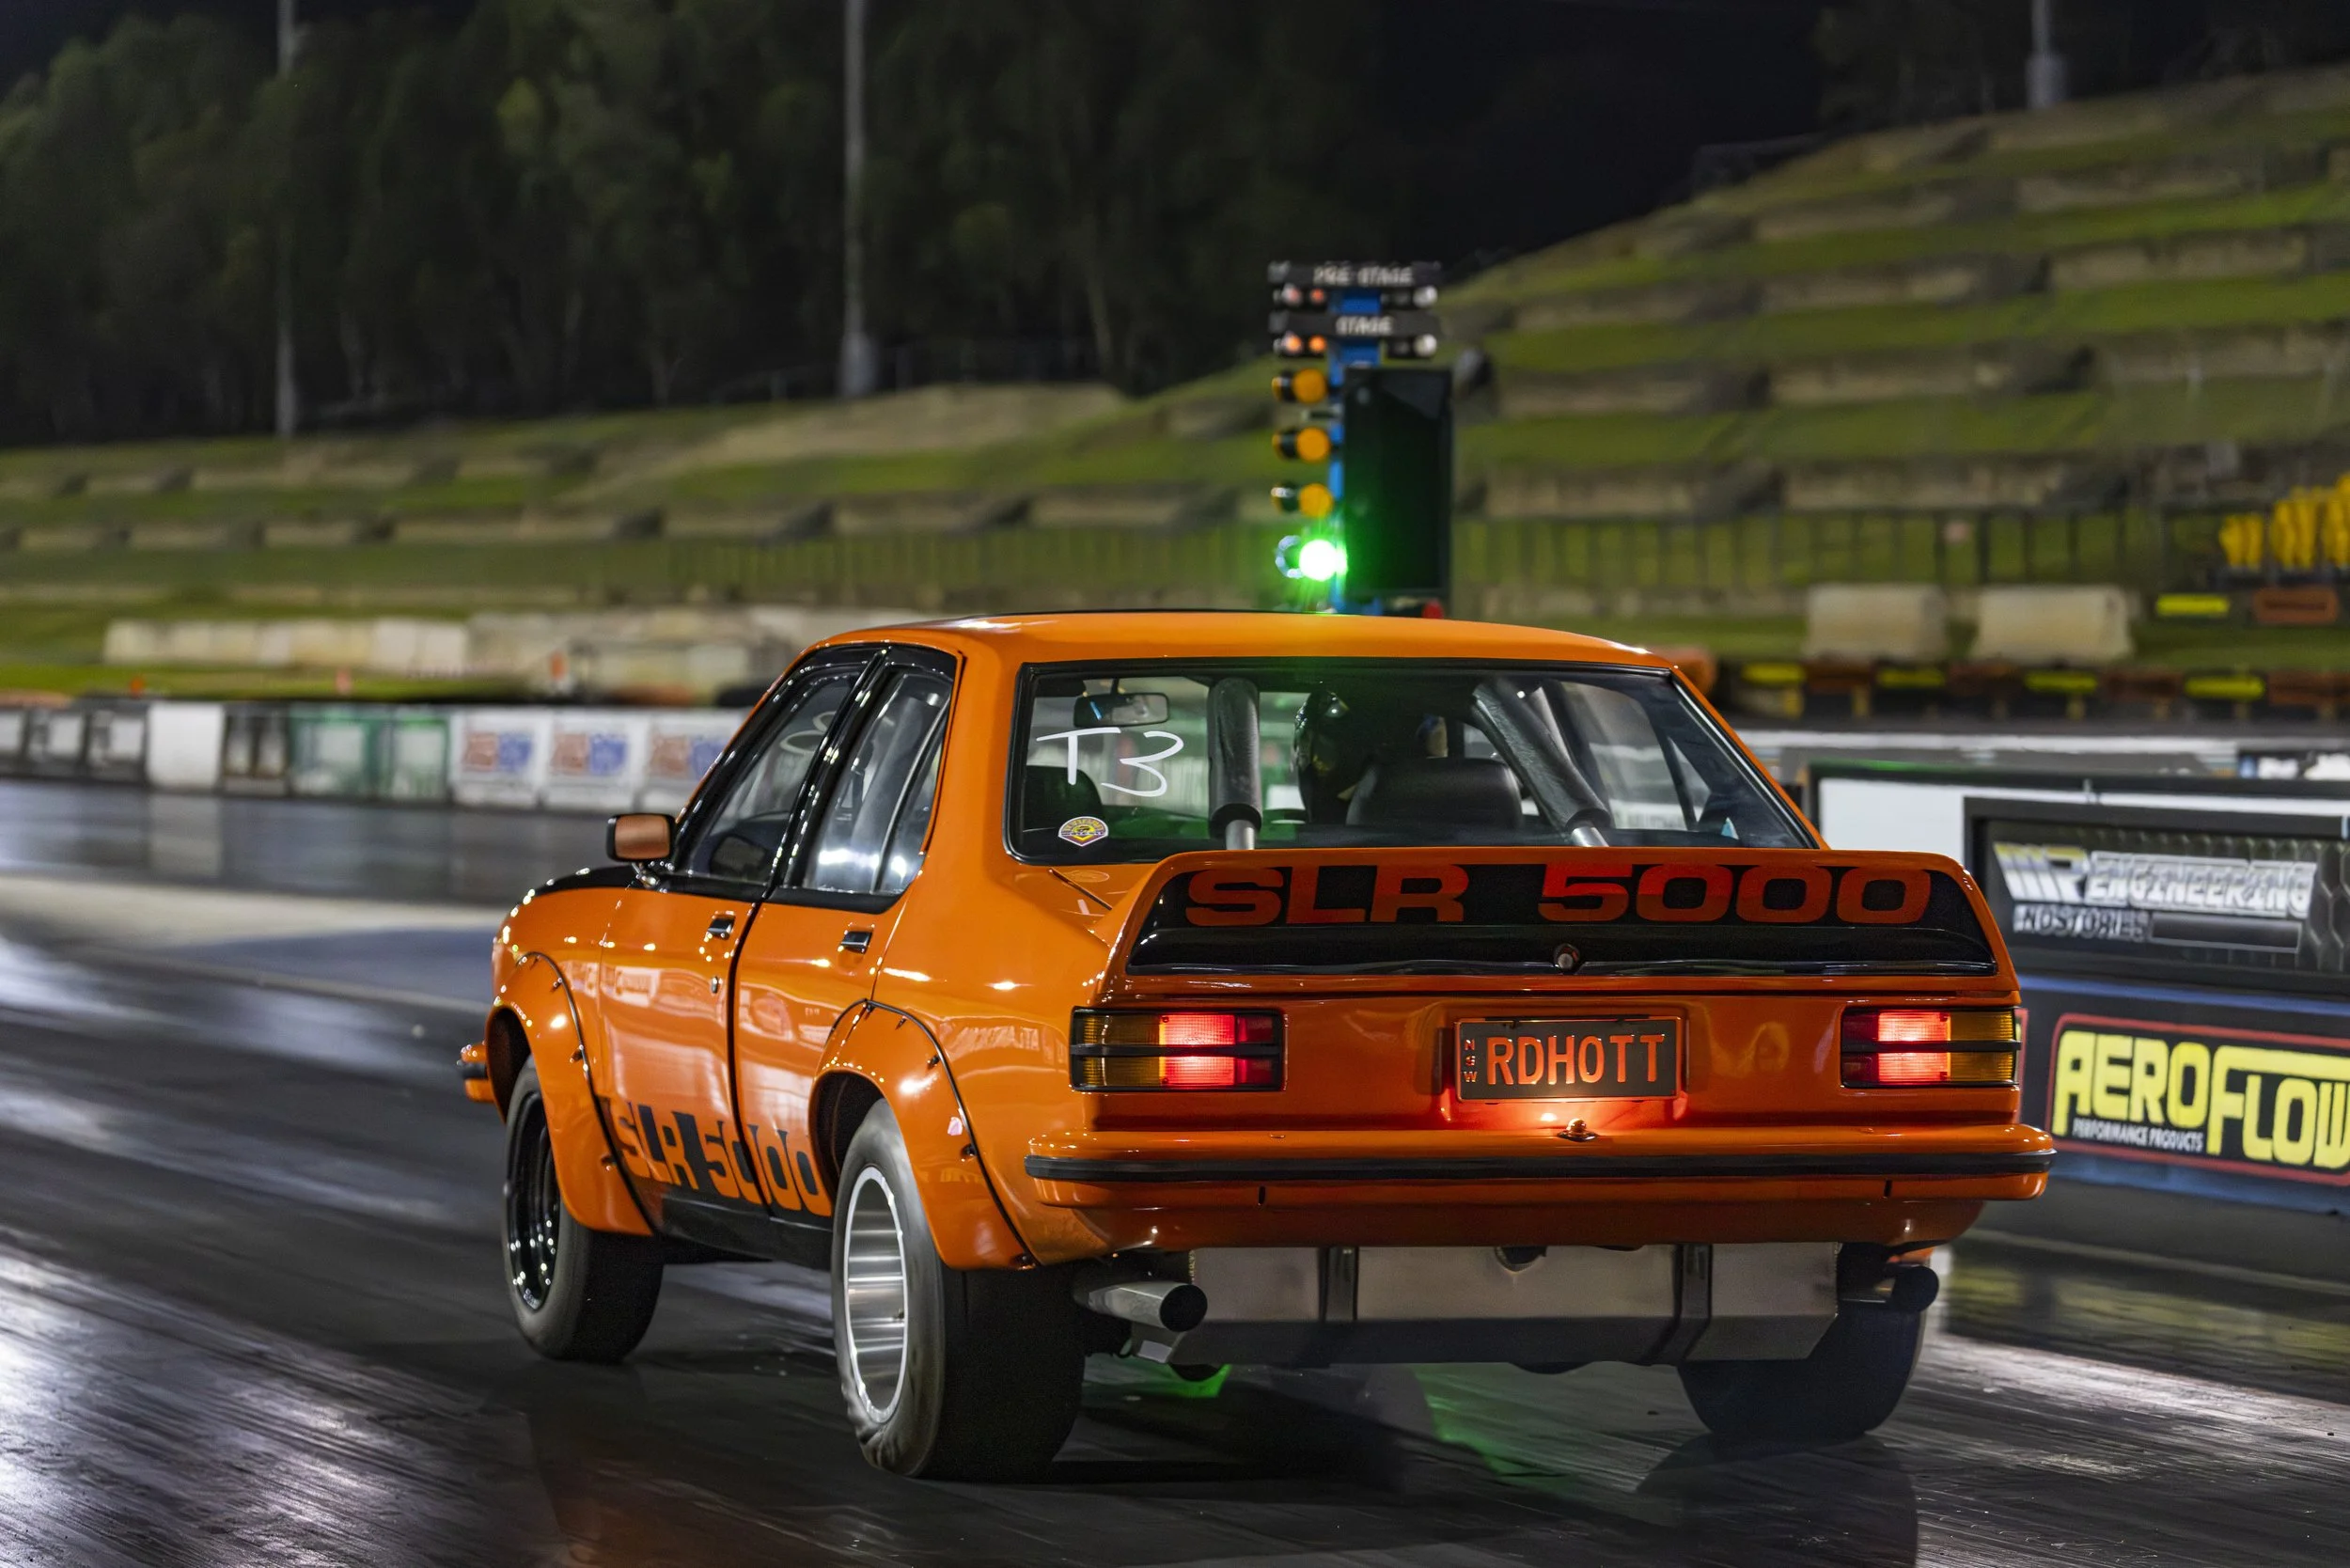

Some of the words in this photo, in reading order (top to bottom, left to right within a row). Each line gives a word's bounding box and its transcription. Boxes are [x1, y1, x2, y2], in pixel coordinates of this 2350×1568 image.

[1357, 266, 1413, 286] STAGE
[1336, 316, 1392, 336] STAGE
[1185, 864, 1469, 926] SLR
[1538, 863, 1932, 924] 5000
[2084, 851, 2317, 918] ENGINEERING
[1486, 1034, 1666, 1085] RDHOTT
[612, 1098, 699, 1191] SLR
[704, 1117, 833, 1217] 5000
[2072, 1117, 2148, 1147] PERFORMANCE
[2149, 1127, 2203, 1152] PRODUCTS
